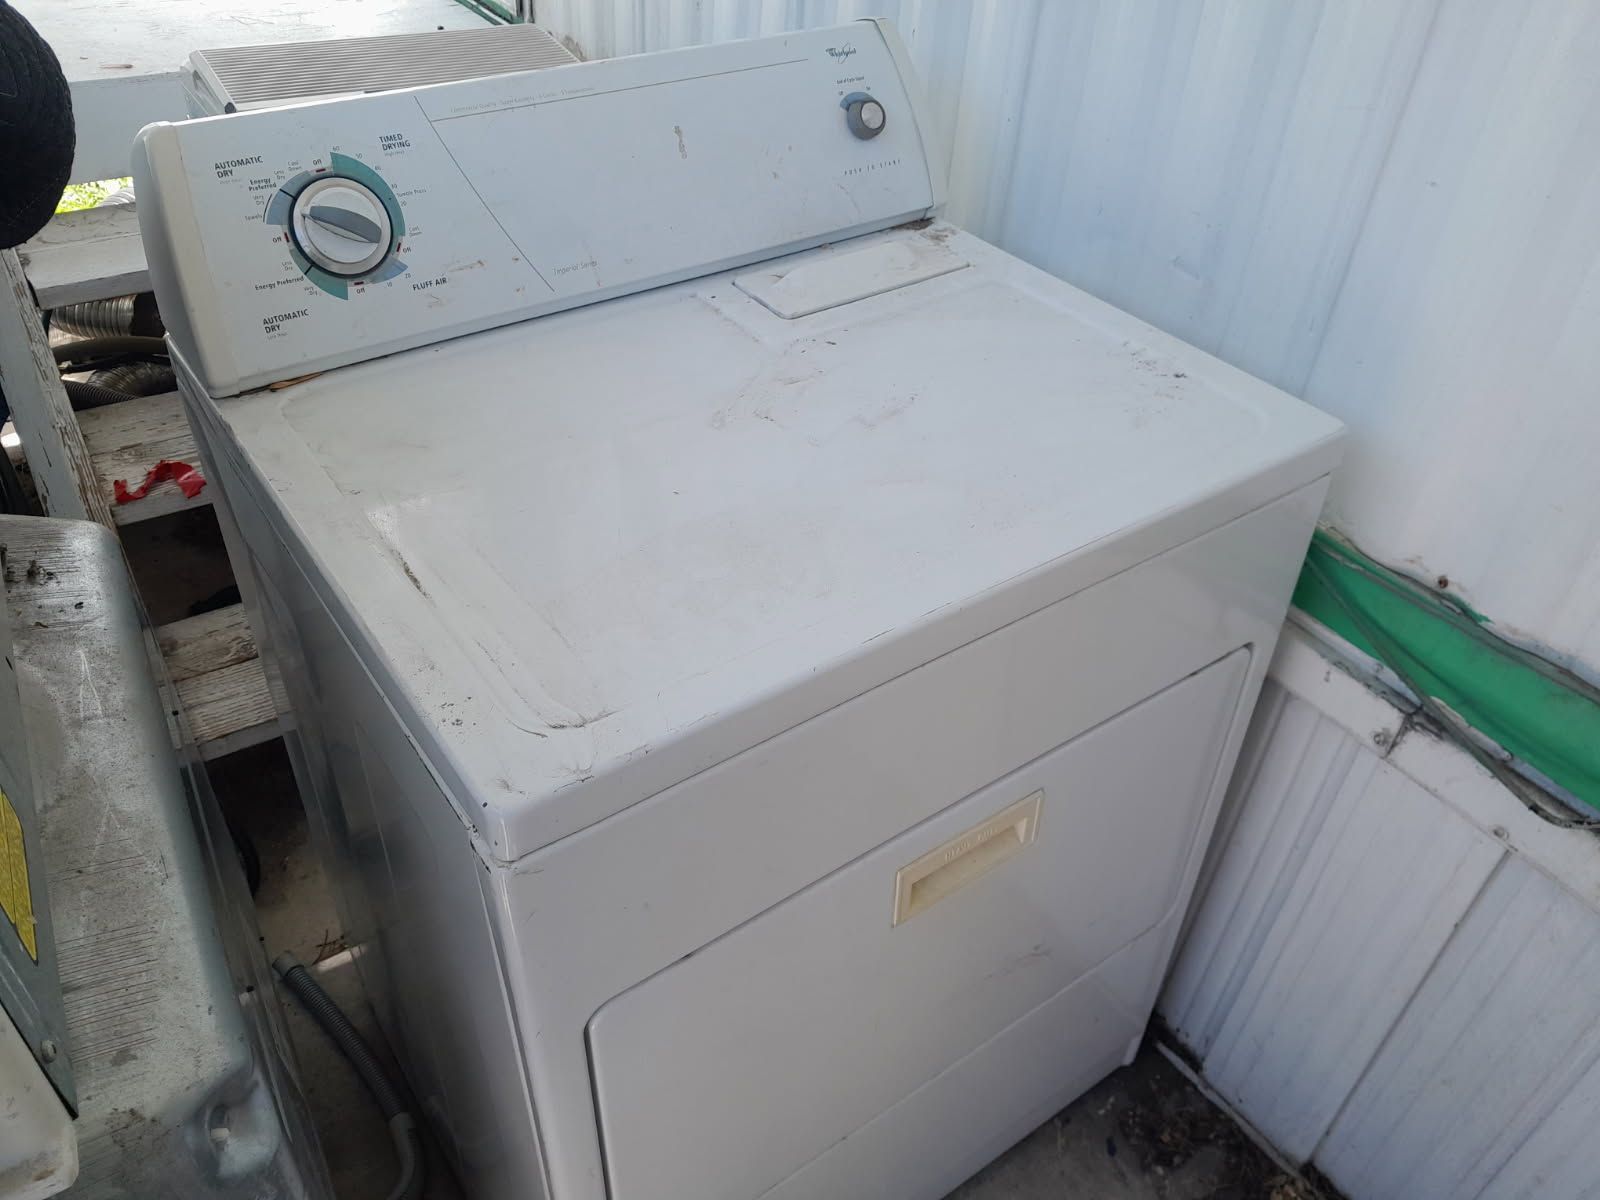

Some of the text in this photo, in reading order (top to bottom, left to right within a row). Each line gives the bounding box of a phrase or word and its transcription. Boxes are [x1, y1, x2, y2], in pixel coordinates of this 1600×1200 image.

[379, 133, 403, 143] TIMED
[382, 140, 411, 151] DRYING
[214, 156, 263, 171] AUTOMATIC
[217, 169, 234, 179] DRY
[249, 177, 271, 186] Energy
[248, 182, 277, 192] Preferred
[255, 275, 305, 291] Energy Preferred
[412, 277, 447, 291] FLUFF AIR
[262, 308, 310, 325] AUTOMATIC
[264, 324, 282, 334] DRY
